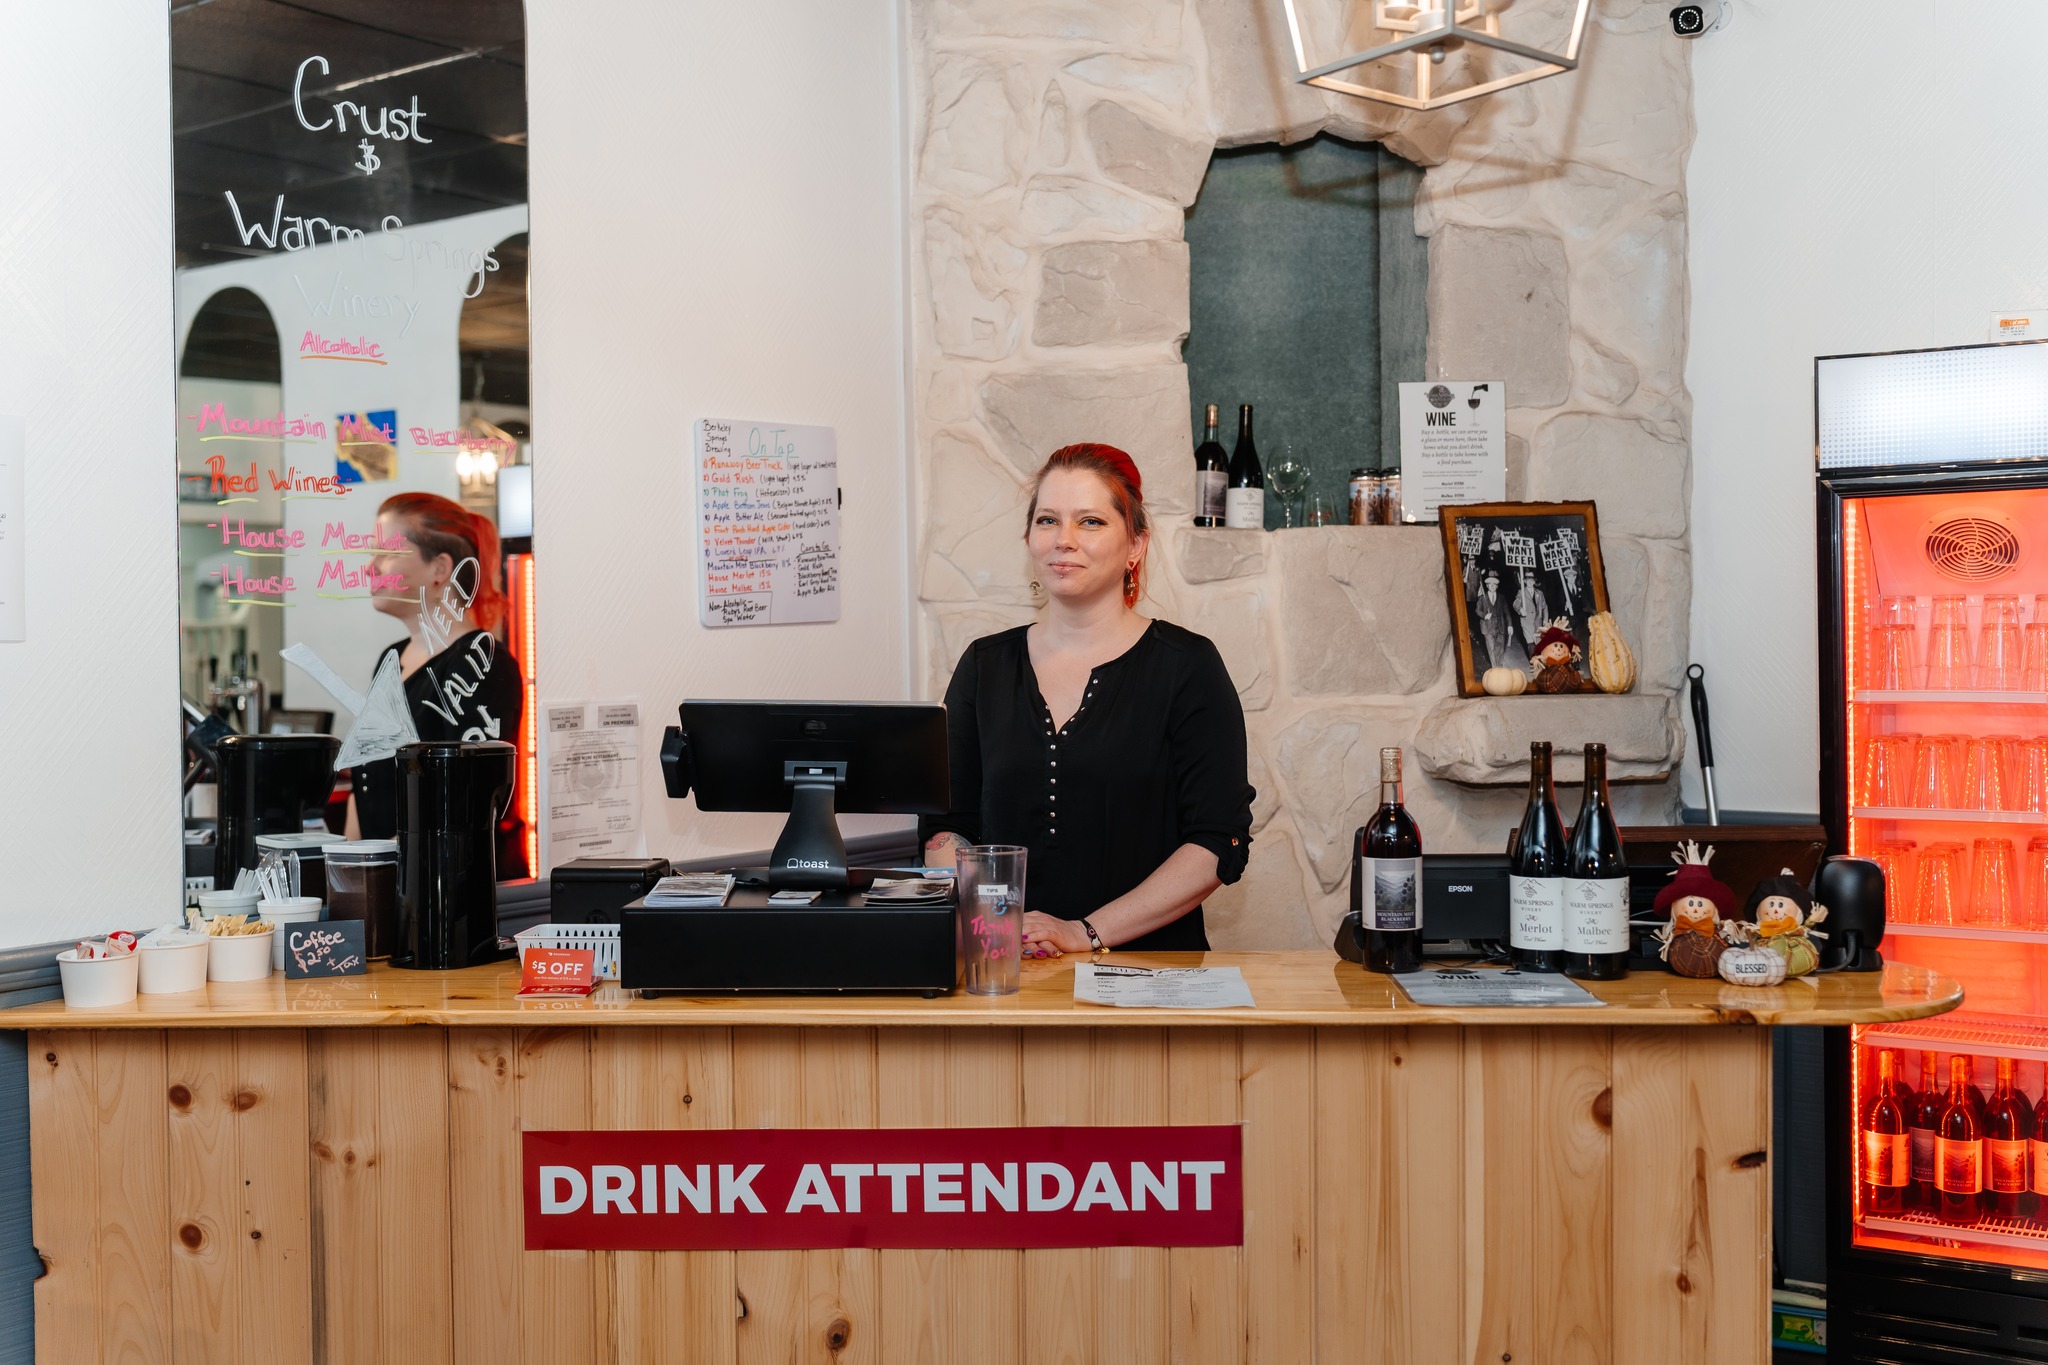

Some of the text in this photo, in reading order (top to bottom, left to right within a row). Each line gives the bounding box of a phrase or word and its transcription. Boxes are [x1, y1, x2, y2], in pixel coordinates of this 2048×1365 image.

[294, 56, 432, 144] Crust
[225, 190, 500, 298] Warm Springs
[295, 271, 421, 338] Winery
[300, 330, 385, 358] Alcoholic
[1426, 412, 1456, 426] WINE
[339, 414, 398, 443] Mist
[409, 426, 516, 468] Blackberry
[749, 427, 795, 462] On Tap
[745, 458, 761, 470] Beer
[711, 472, 731, 483] Gold
[734, 473, 755, 484] Rush
[733, 487, 748, 502] Frog
[753, 512, 764, 522] Ale
[321, 521, 408, 551] Merlot
[1509, 537, 1531, 547] WE
[753, 545, 767, 555] IPA
[1507, 545, 1533, 556] WANT
[1544, 541, 1565, 551] WE
[1507, 555, 1534, 566] BEER
[1543, 548, 1569, 560] WANT
[1545, 556, 1572, 569] BEER
[317, 559, 410, 589] Malbec
[708, 573, 729, 582] House
[732, 570, 755, 580] Merlot
[709, 584, 728, 594] House
[732, 583, 753, 593] Malbec
[397, 556, 481, 656] NEED
[422, 631, 496, 727] VALID
[799, 859, 829, 869] toast
[1448, 885, 1473, 893] EPSON
[1519, 922, 1553, 934] Merlot
[1577, 926, 1612, 936] Malbec
[289, 930, 346, 952] Coffee
[331, 954, 360, 974] Tax
[532, 960, 584, 975] $5 OFF
[1735, 963, 1768, 975] BLESSED
[539, 1160, 1226, 1216] DRINK ATTENDANT
